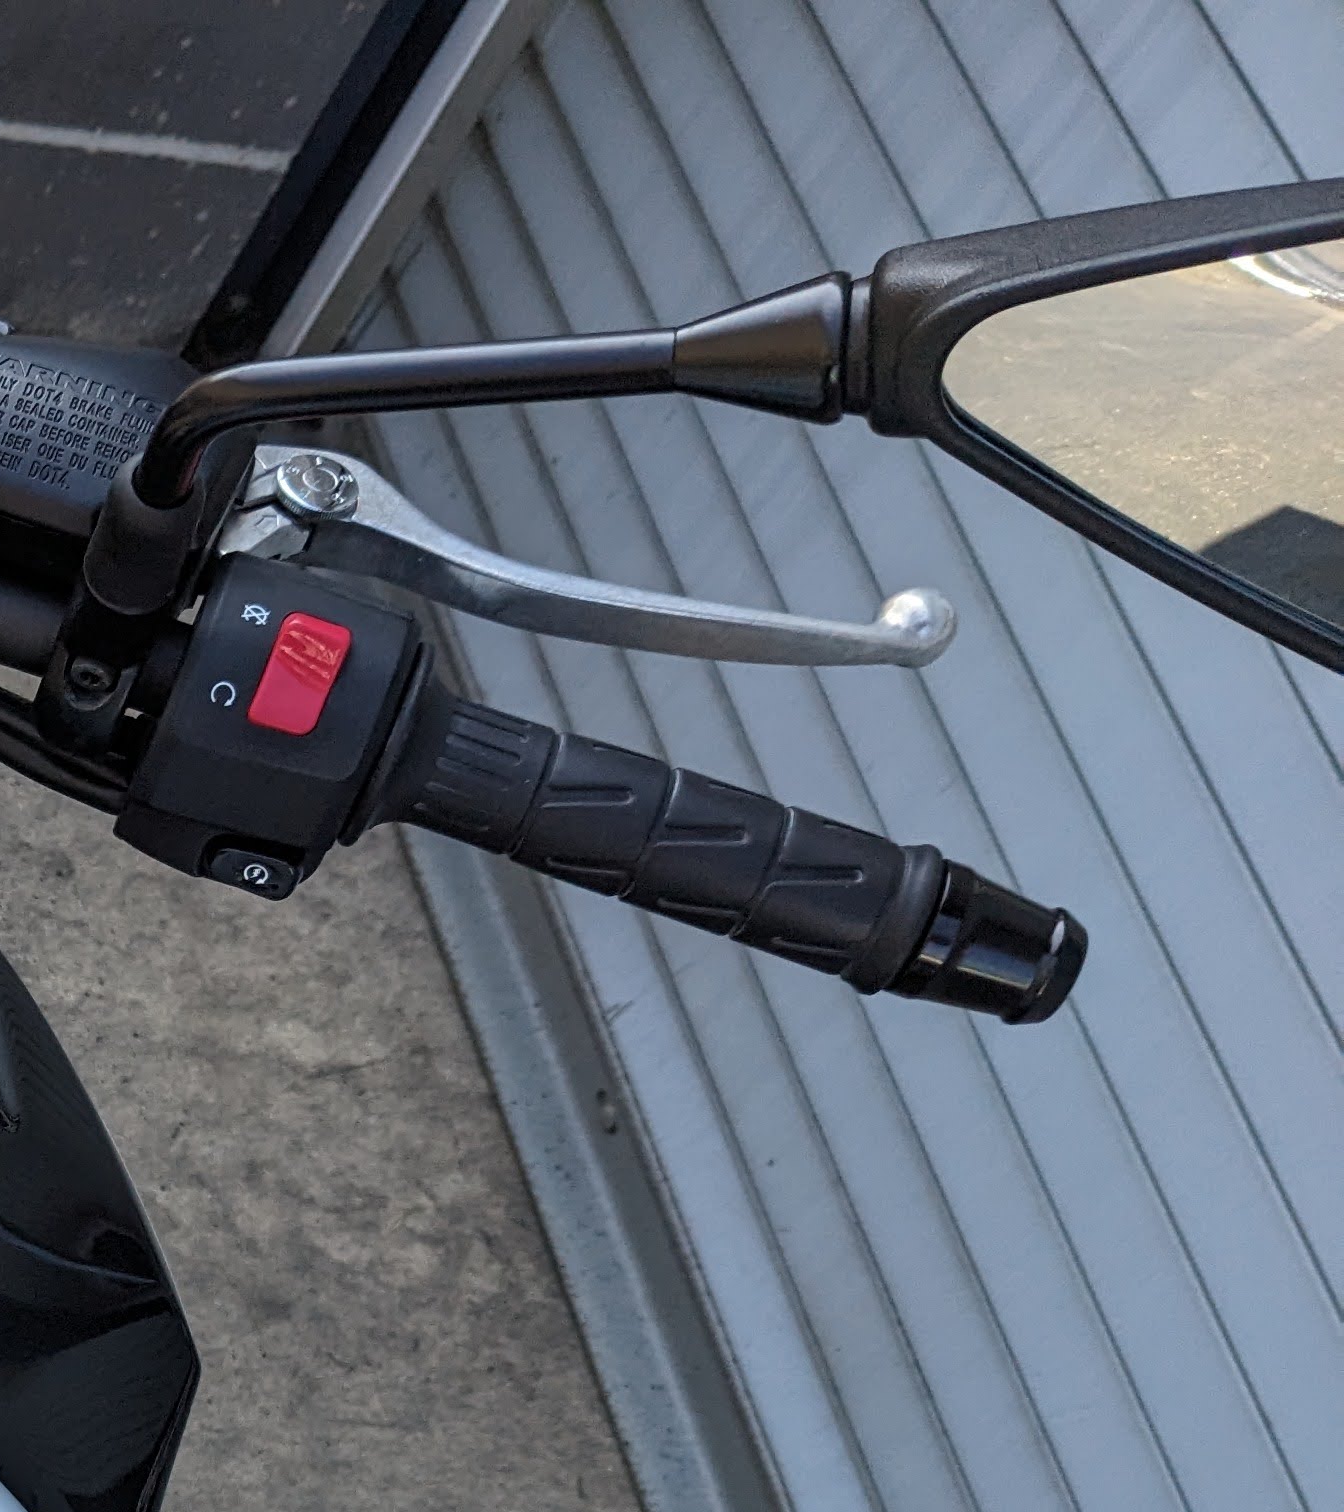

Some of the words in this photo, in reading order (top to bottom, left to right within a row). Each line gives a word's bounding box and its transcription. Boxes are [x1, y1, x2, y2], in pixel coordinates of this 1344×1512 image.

[0, 394, 10, 408] A
[14, 398, 64, 422] SEALED
[22, 382, 63, 406] DOT4
[69, 396, 113, 421] BRAKE
[9, 415, 35, 433] CAP
[39, 424, 91, 451] BEFORE
[68, 453, 89, 471] DU
